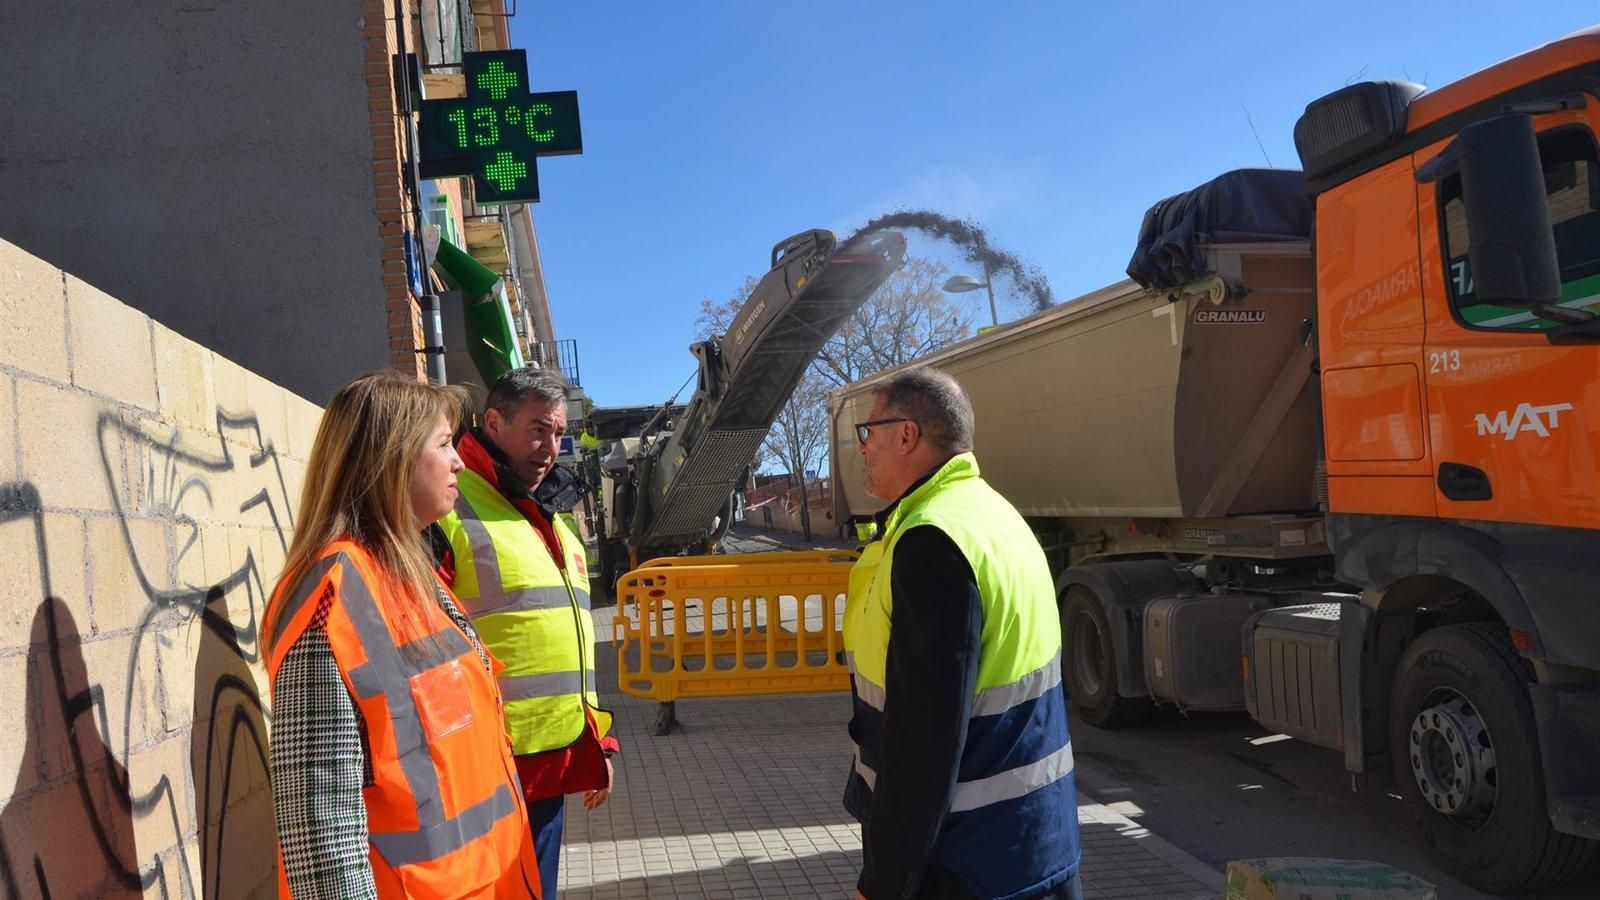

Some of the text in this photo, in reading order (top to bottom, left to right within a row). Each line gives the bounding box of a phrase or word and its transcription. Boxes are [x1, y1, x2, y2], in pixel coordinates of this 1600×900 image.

[1197, 311, 1266, 322] GRANALU
[1430, 350, 1460, 374] 213
[1474, 402, 1574, 441] MAT
